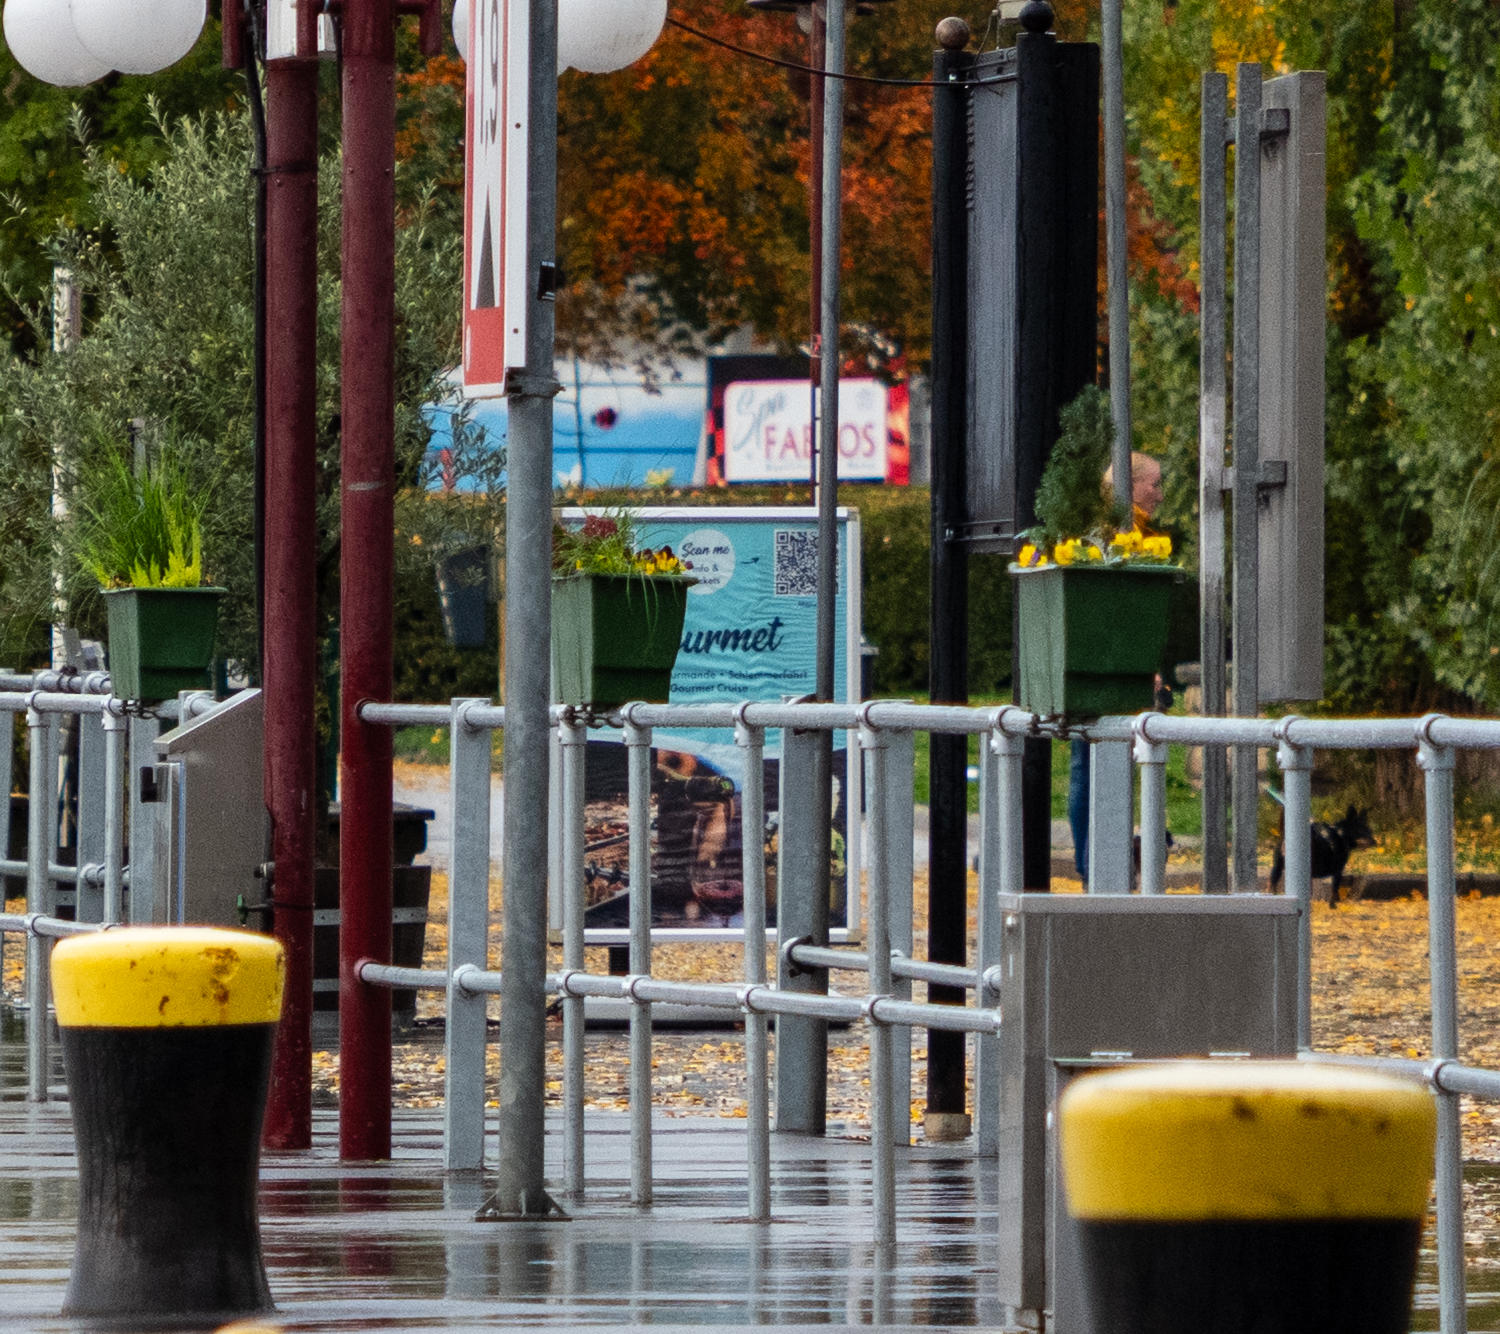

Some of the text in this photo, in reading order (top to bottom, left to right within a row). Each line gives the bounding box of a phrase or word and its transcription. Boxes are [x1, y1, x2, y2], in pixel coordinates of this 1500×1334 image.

[681, 542, 730, 558] Scan me
[679, 616, 785, 654] urmet
[717, 682, 749, 693] Cruise
